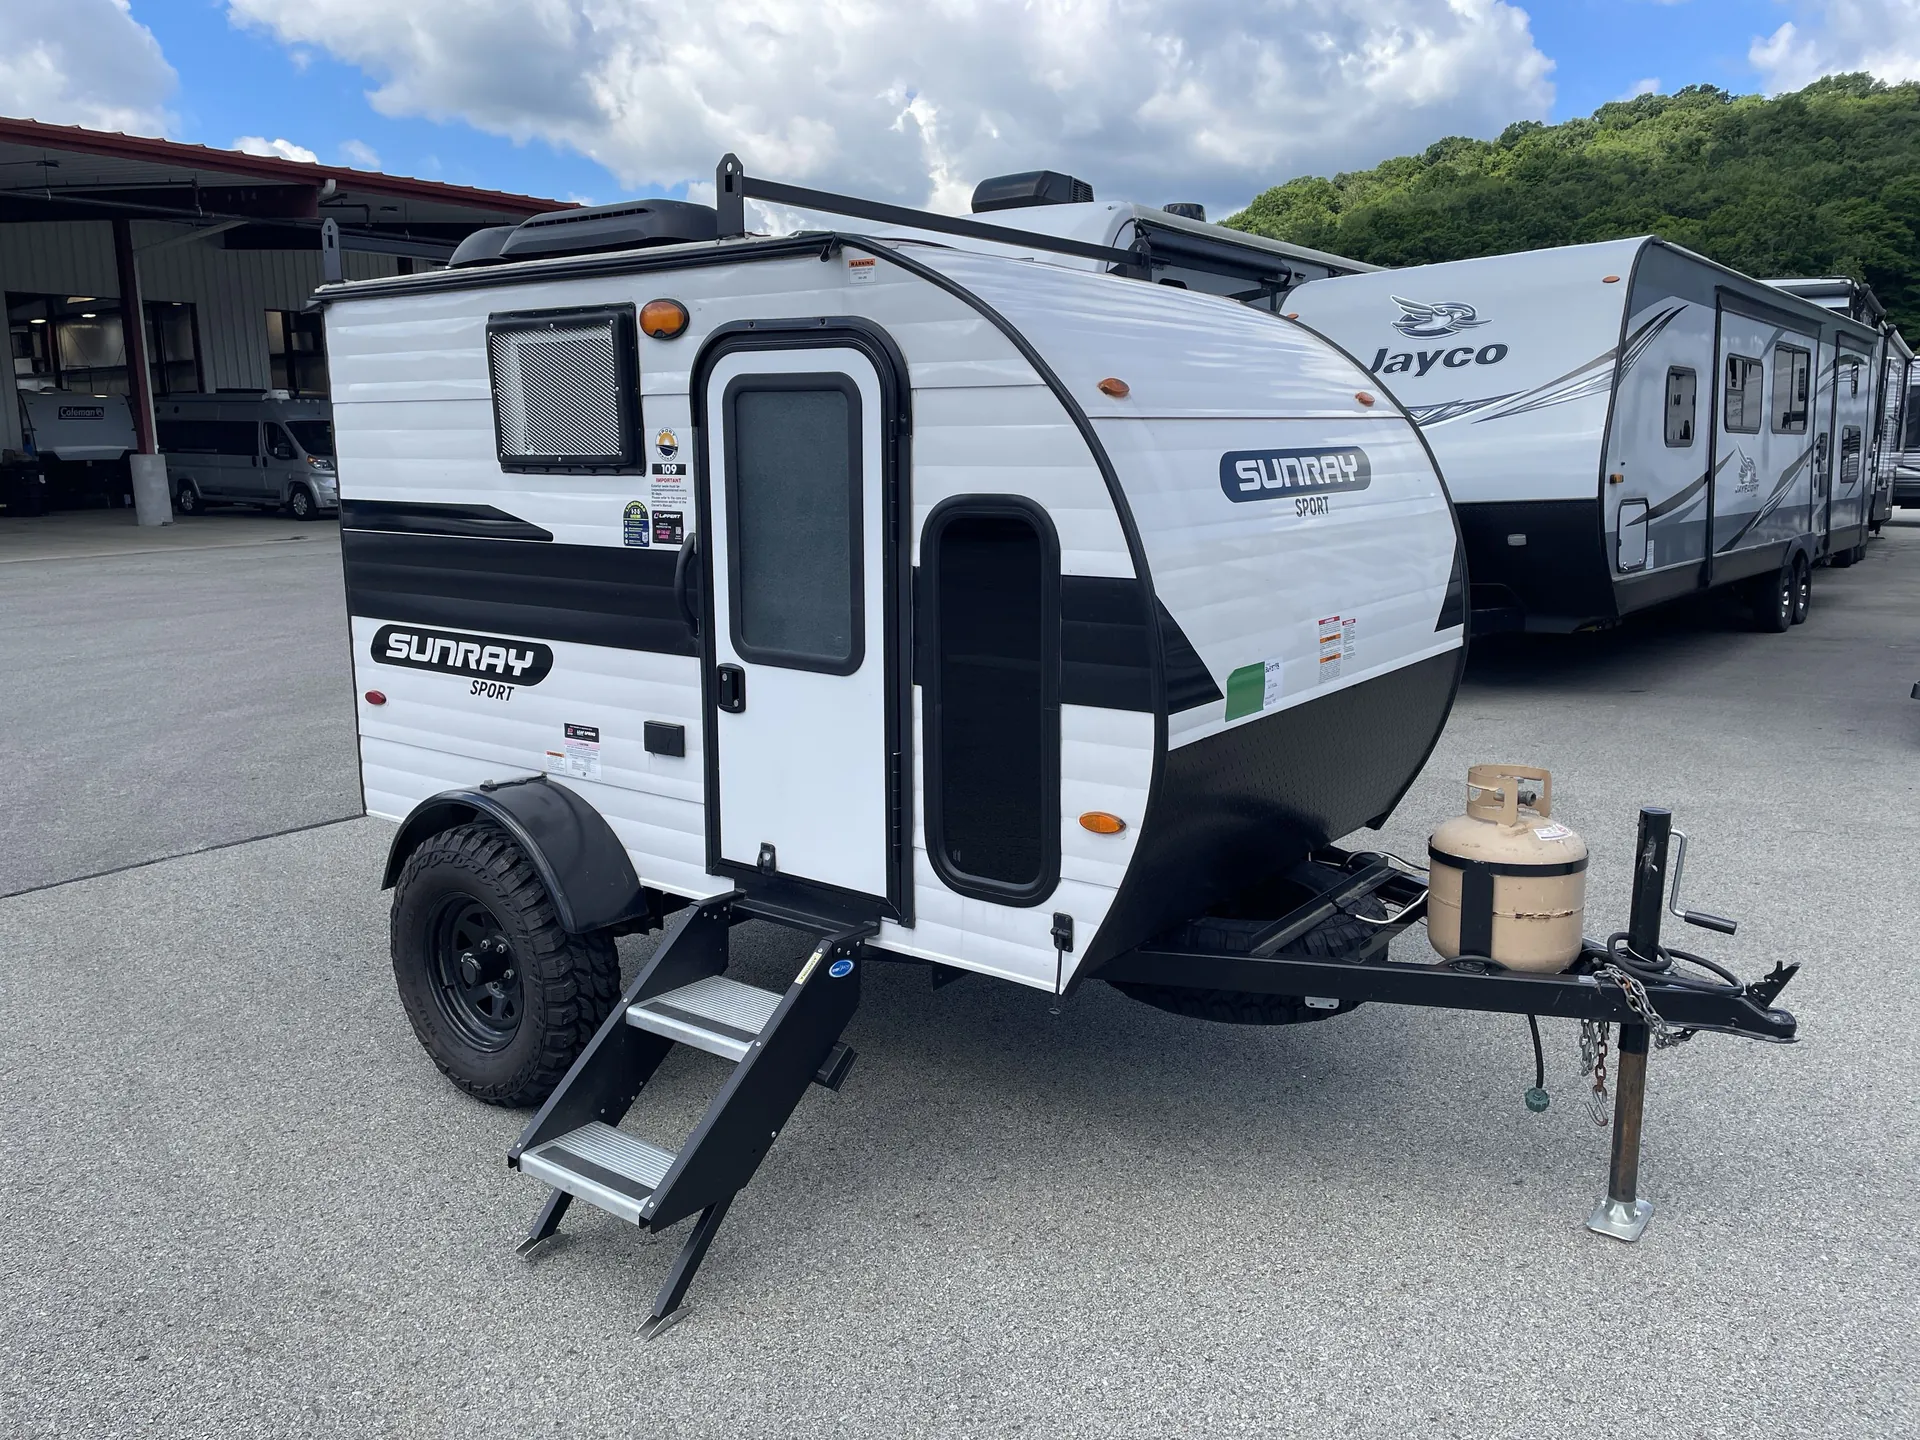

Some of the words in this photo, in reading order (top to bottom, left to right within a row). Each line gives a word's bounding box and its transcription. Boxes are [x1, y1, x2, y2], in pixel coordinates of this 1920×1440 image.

[1370, 343, 1509, 377] Jayco
[60, 407, 95, 417] Coleman
[661, 464, 677, 475] 109
[1235, 454, 1358, 492] SUNRAY
[1295, 496, 1329, 518] SPORT
[385, 632, 534, 677] SUNRAY
[470, 680, 514, 702] SPORT
